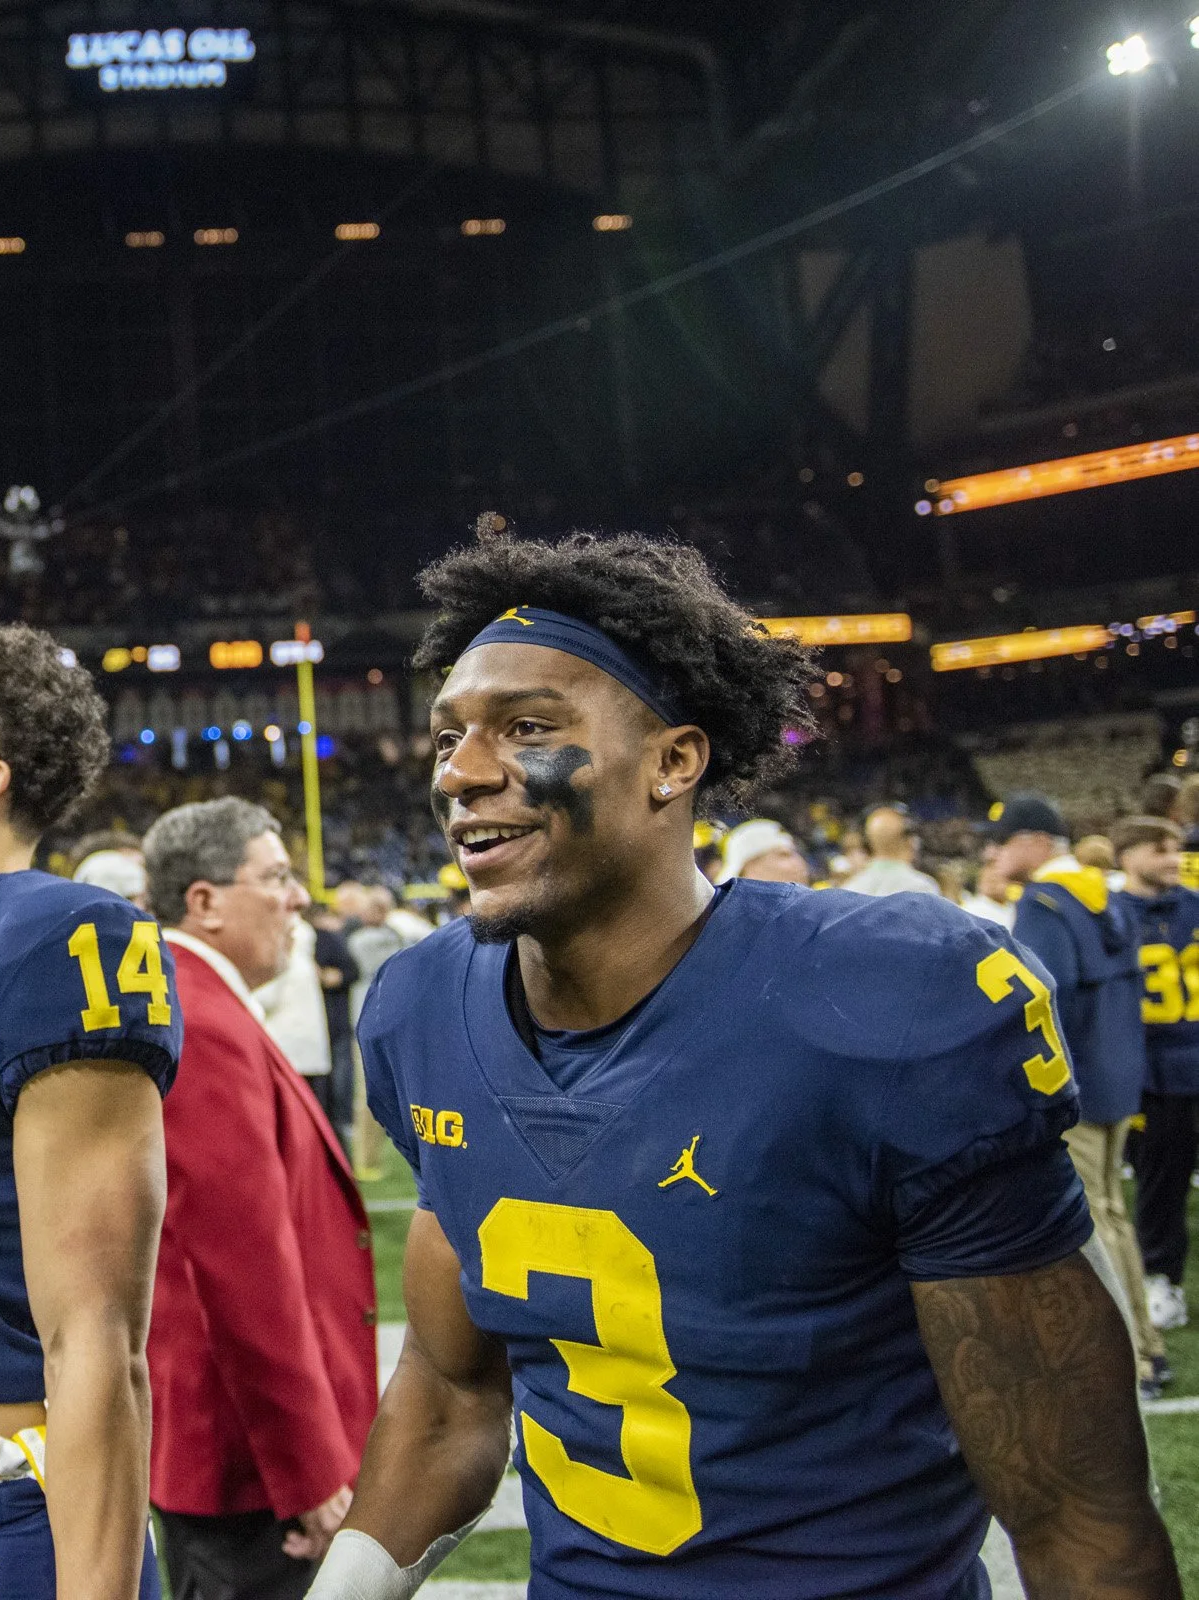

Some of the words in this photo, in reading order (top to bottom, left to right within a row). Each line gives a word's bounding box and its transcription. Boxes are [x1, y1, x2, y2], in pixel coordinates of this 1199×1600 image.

[65, 28, 187, 68] LUCAS
[187, 27, 256, 63] OIL
[68, 921, 172, 1033] 14
[976, 947, 1071, 1096] 3
[477, 1197, 702, 1557] 3
